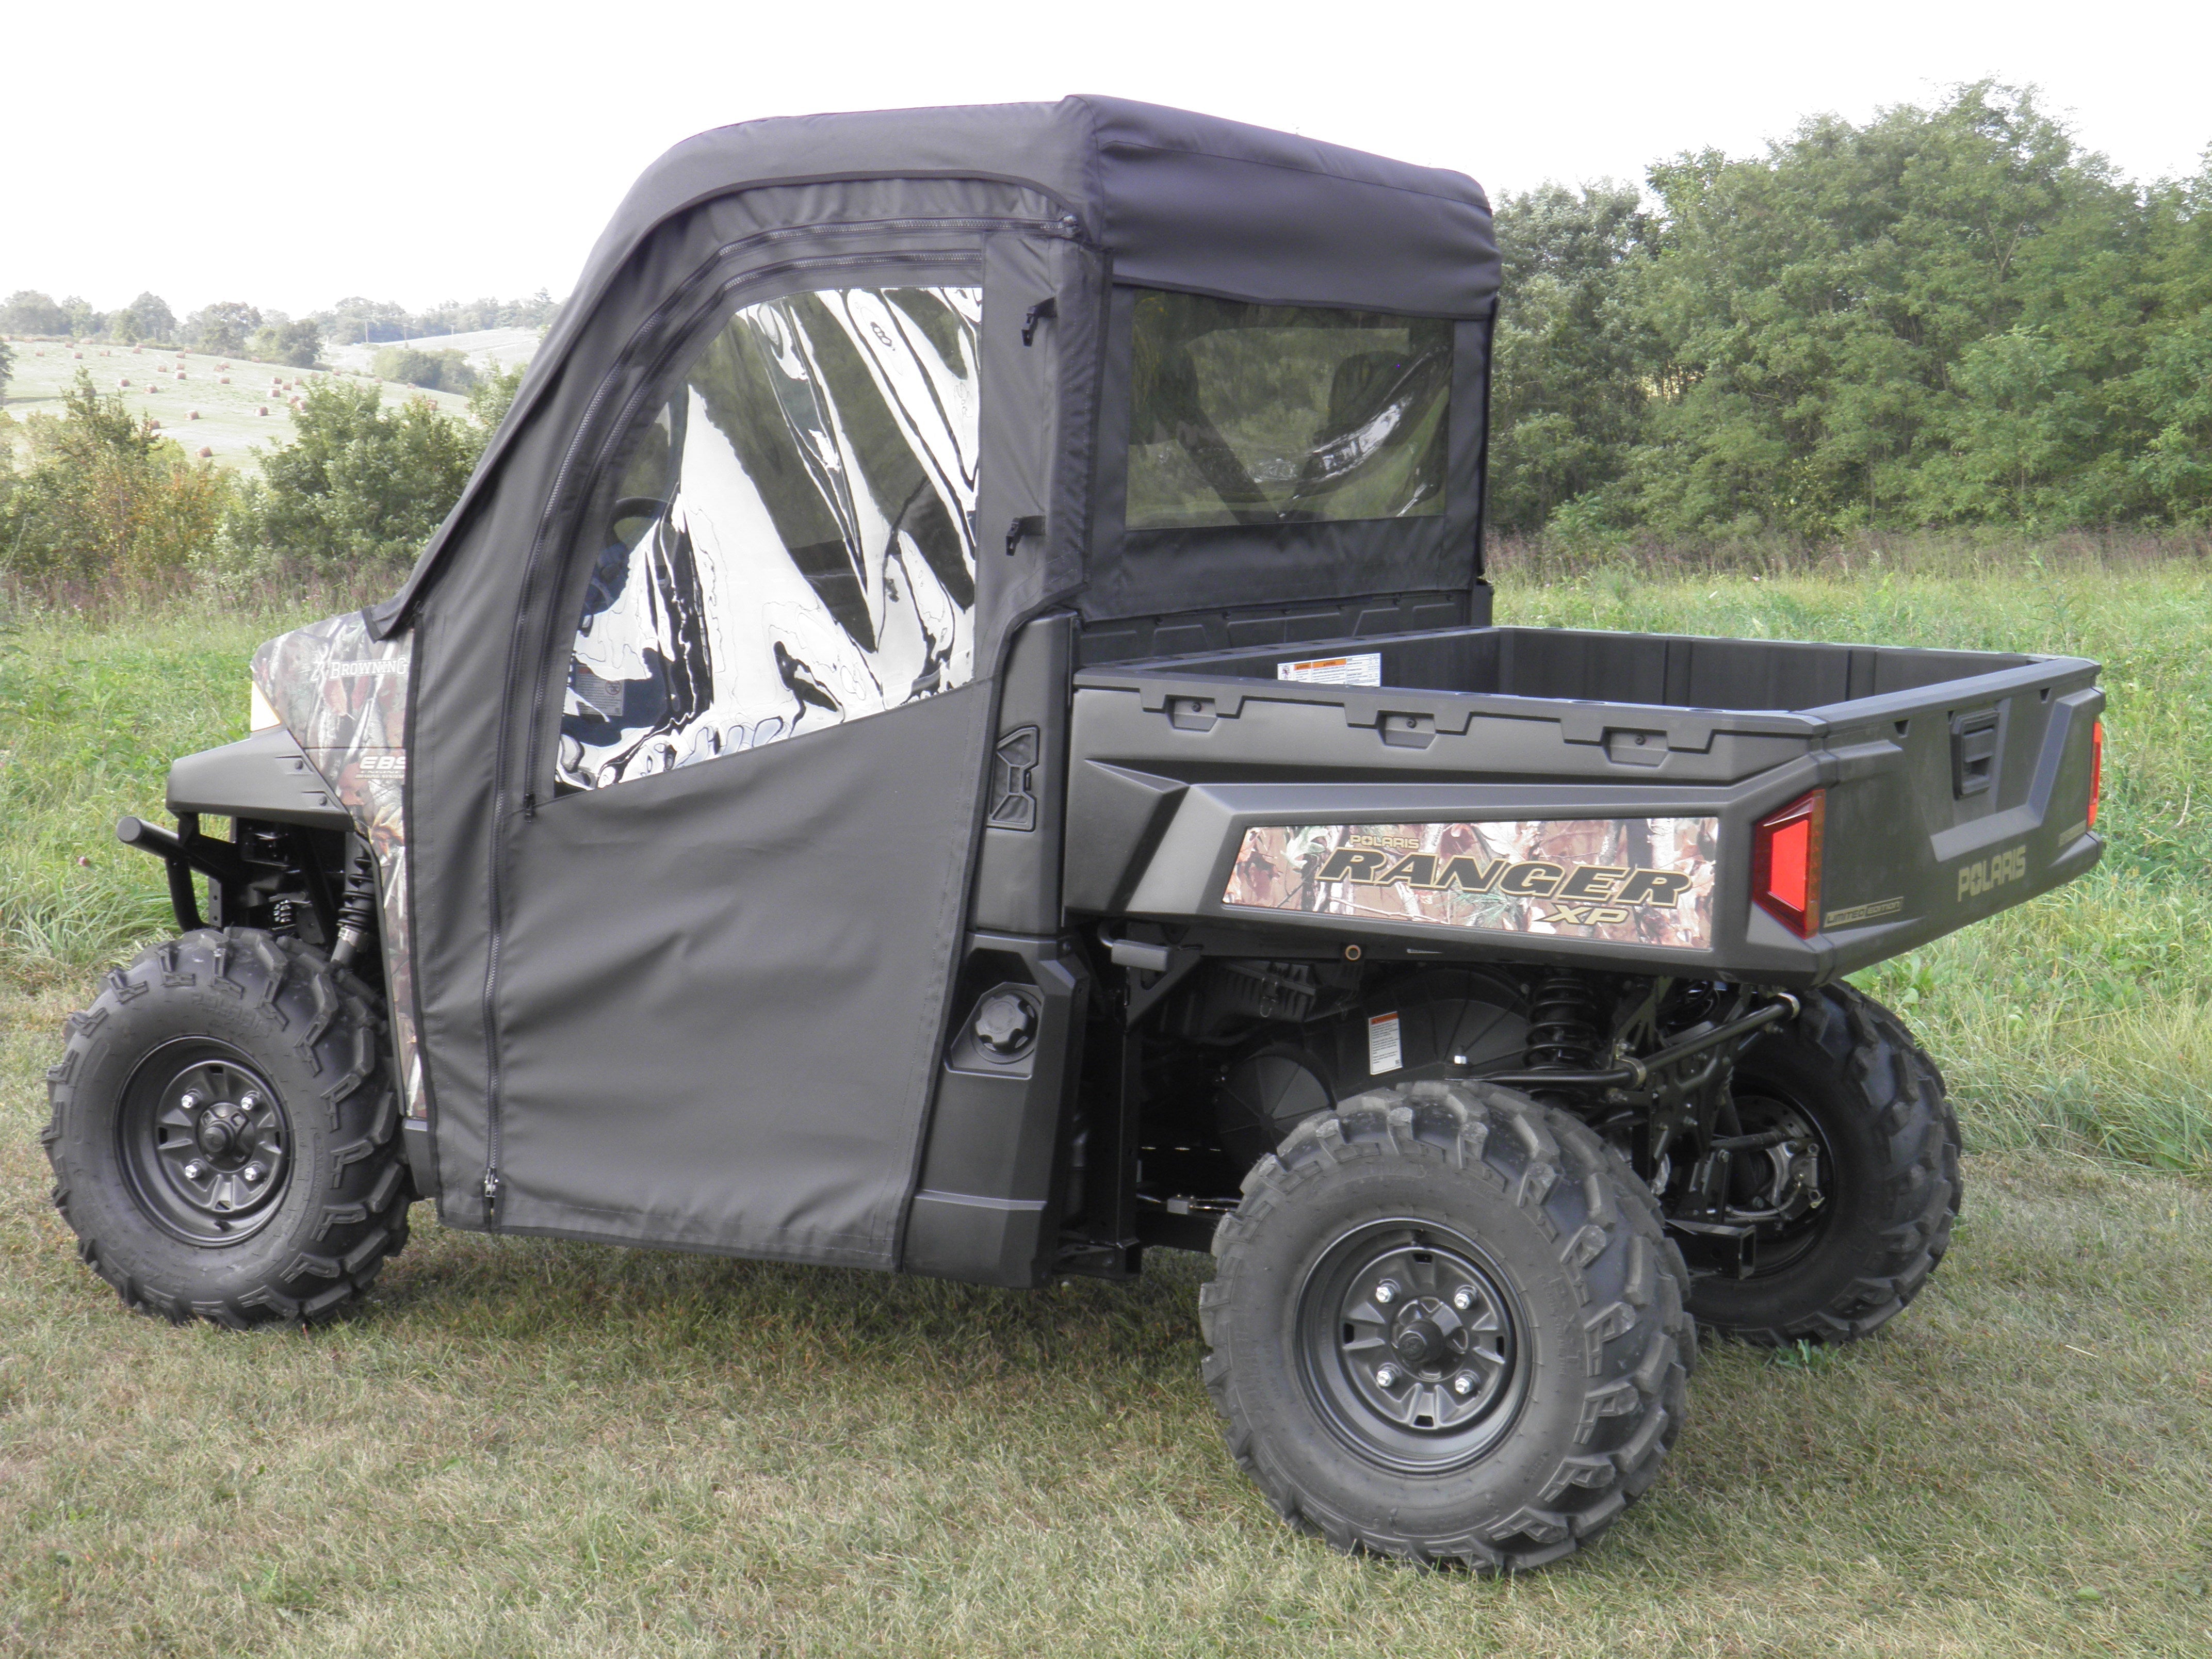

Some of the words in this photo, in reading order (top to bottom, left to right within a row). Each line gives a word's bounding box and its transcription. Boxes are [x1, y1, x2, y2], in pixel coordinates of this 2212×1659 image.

[330, 656, 409, 679] BROWNING
[1349, 834, 1419, 849] POLARIS
[1316, 847, 1693, 908] RANGER
[1958, 845, 2026, 902] POLARIS
[1539, 904, 1629, 925] XP
